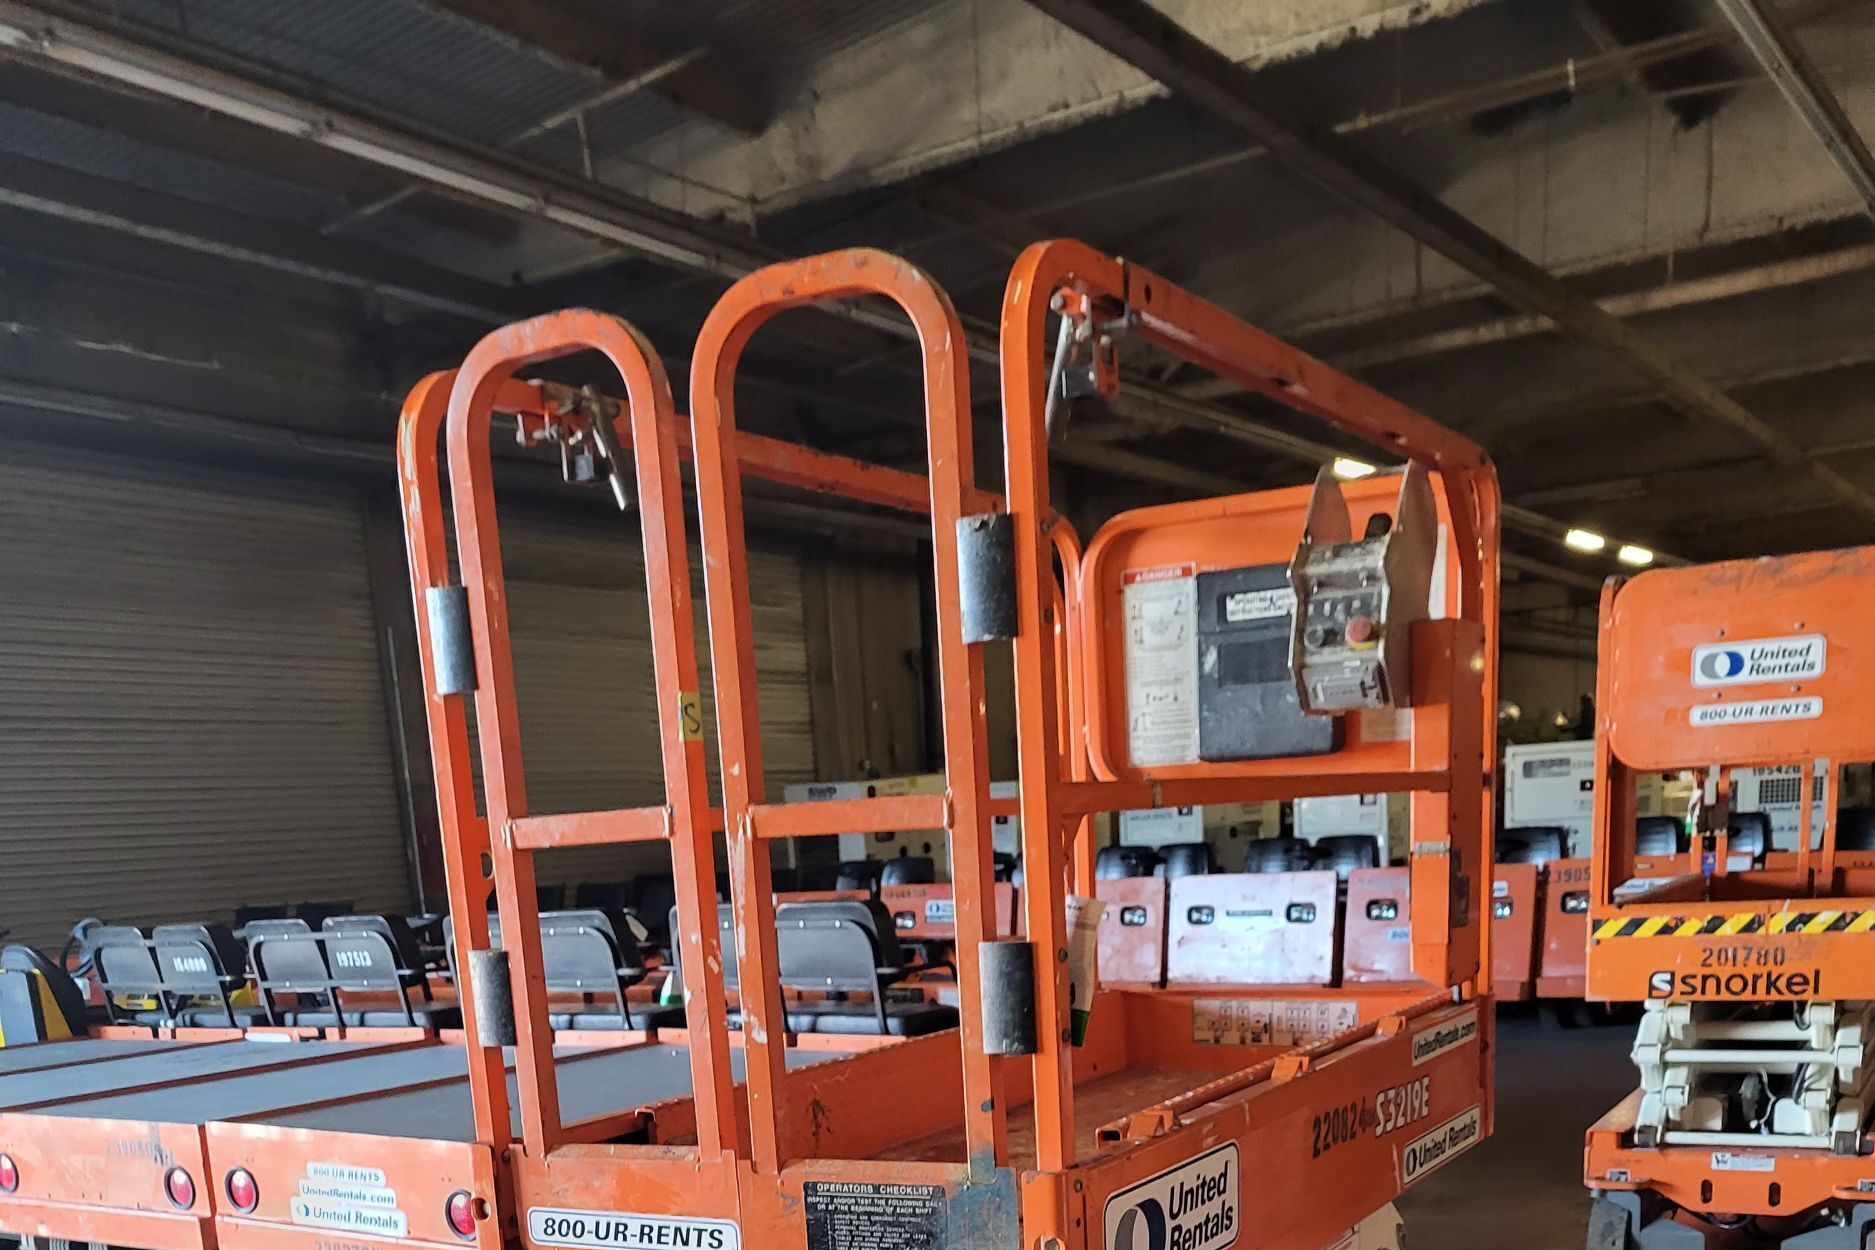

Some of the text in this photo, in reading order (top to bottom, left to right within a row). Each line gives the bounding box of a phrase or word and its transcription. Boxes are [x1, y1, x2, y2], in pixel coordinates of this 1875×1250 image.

[1750, 642, 1812, 662] United
[1749, 658, 1816, 676] Rentals
[684, 702, 700, 734] S
[1700, 945, 1786, 968] 201780
[1679, 968, 1821, 997] snorkel
[1414, 1017, 1476, 1060] UnitedRentals.com
[1419, 1115, 1478, 1168] United Rentals
[302, 1184, 395, 1205] UnitedRentals.com
[816, 1182, 934, 1196] OPERATORS CHECKLIST
[1168, 1160, 1230, 1221] United
[313, 1206, 399, 1230] United Rentals
[543, 1216, 724, 1250] 800-UR-RENTS
